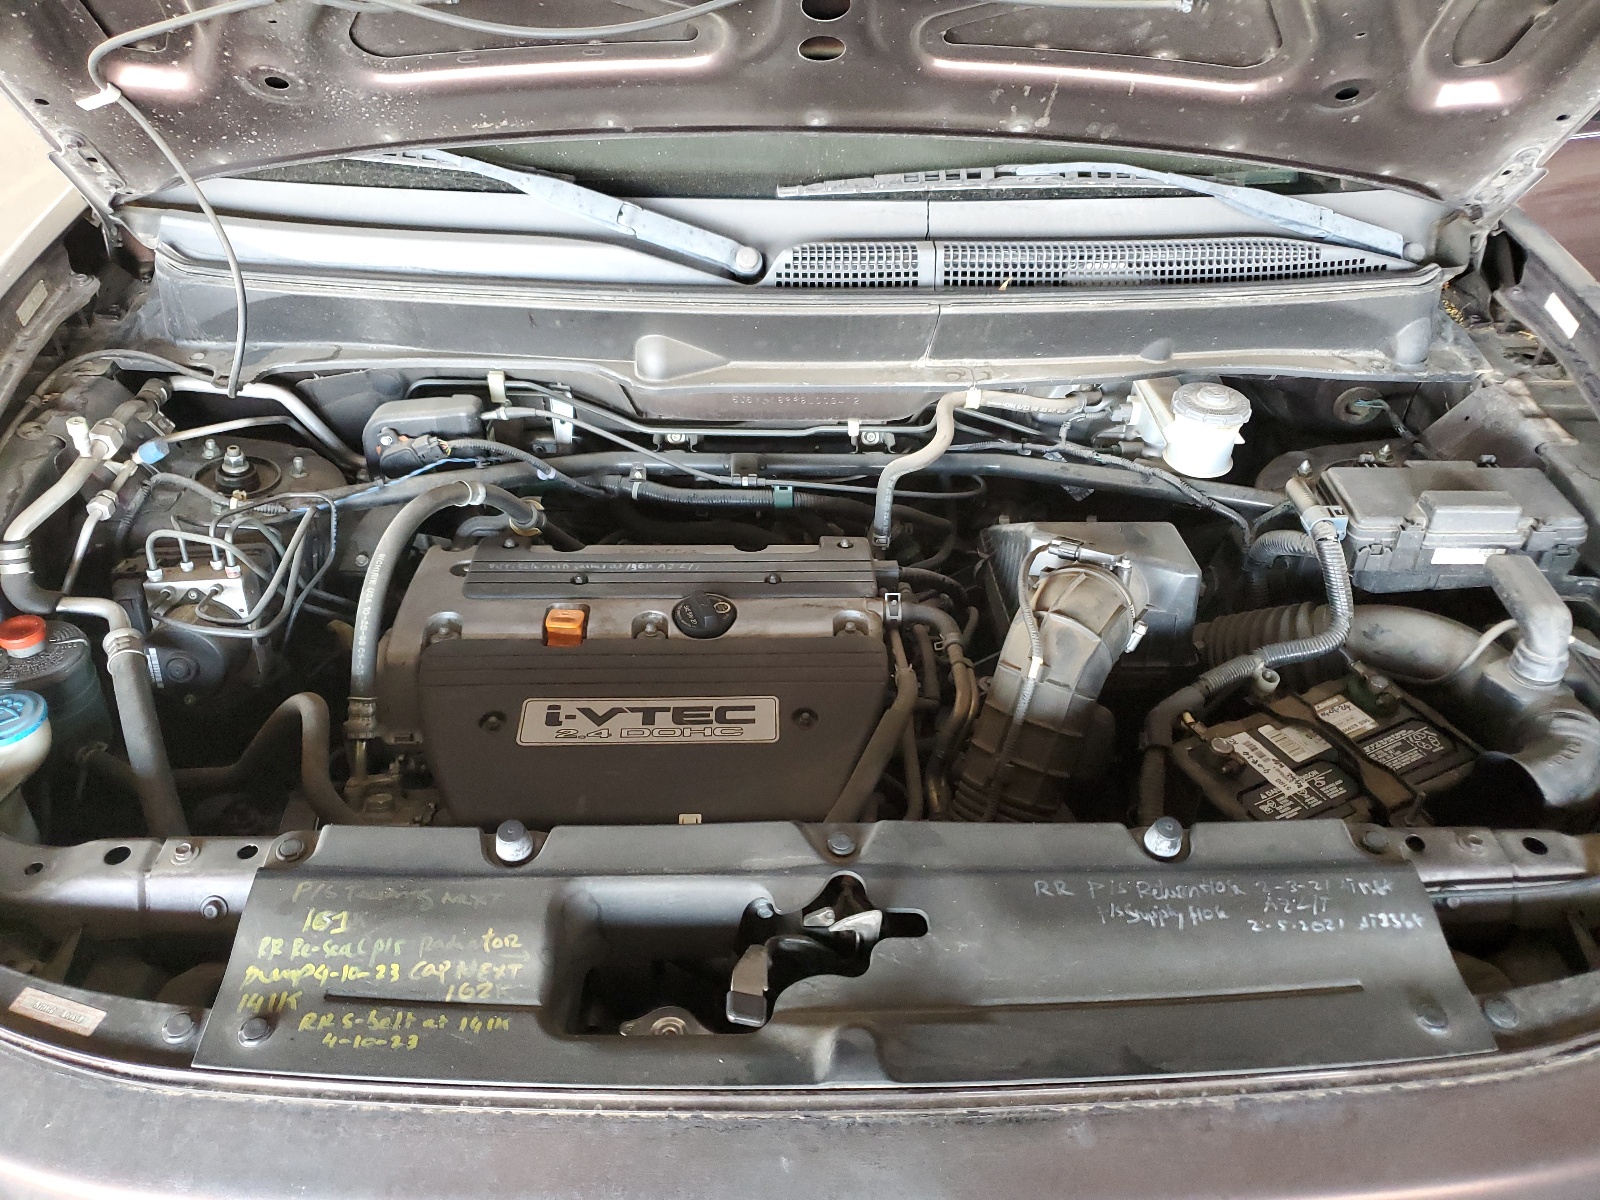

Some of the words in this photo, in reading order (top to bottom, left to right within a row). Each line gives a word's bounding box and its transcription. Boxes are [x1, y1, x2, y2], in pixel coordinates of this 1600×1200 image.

[544, 704, 756, 727] i-VTEC
[555, 728, 613, 740] 2.4
[619, 726, 744, 739] DOHC
[1033, 878, 1077, 898] RR
[1086, 878, 1128, 899] P/S
[321, 1032, 419, 1051] 4-10-23
